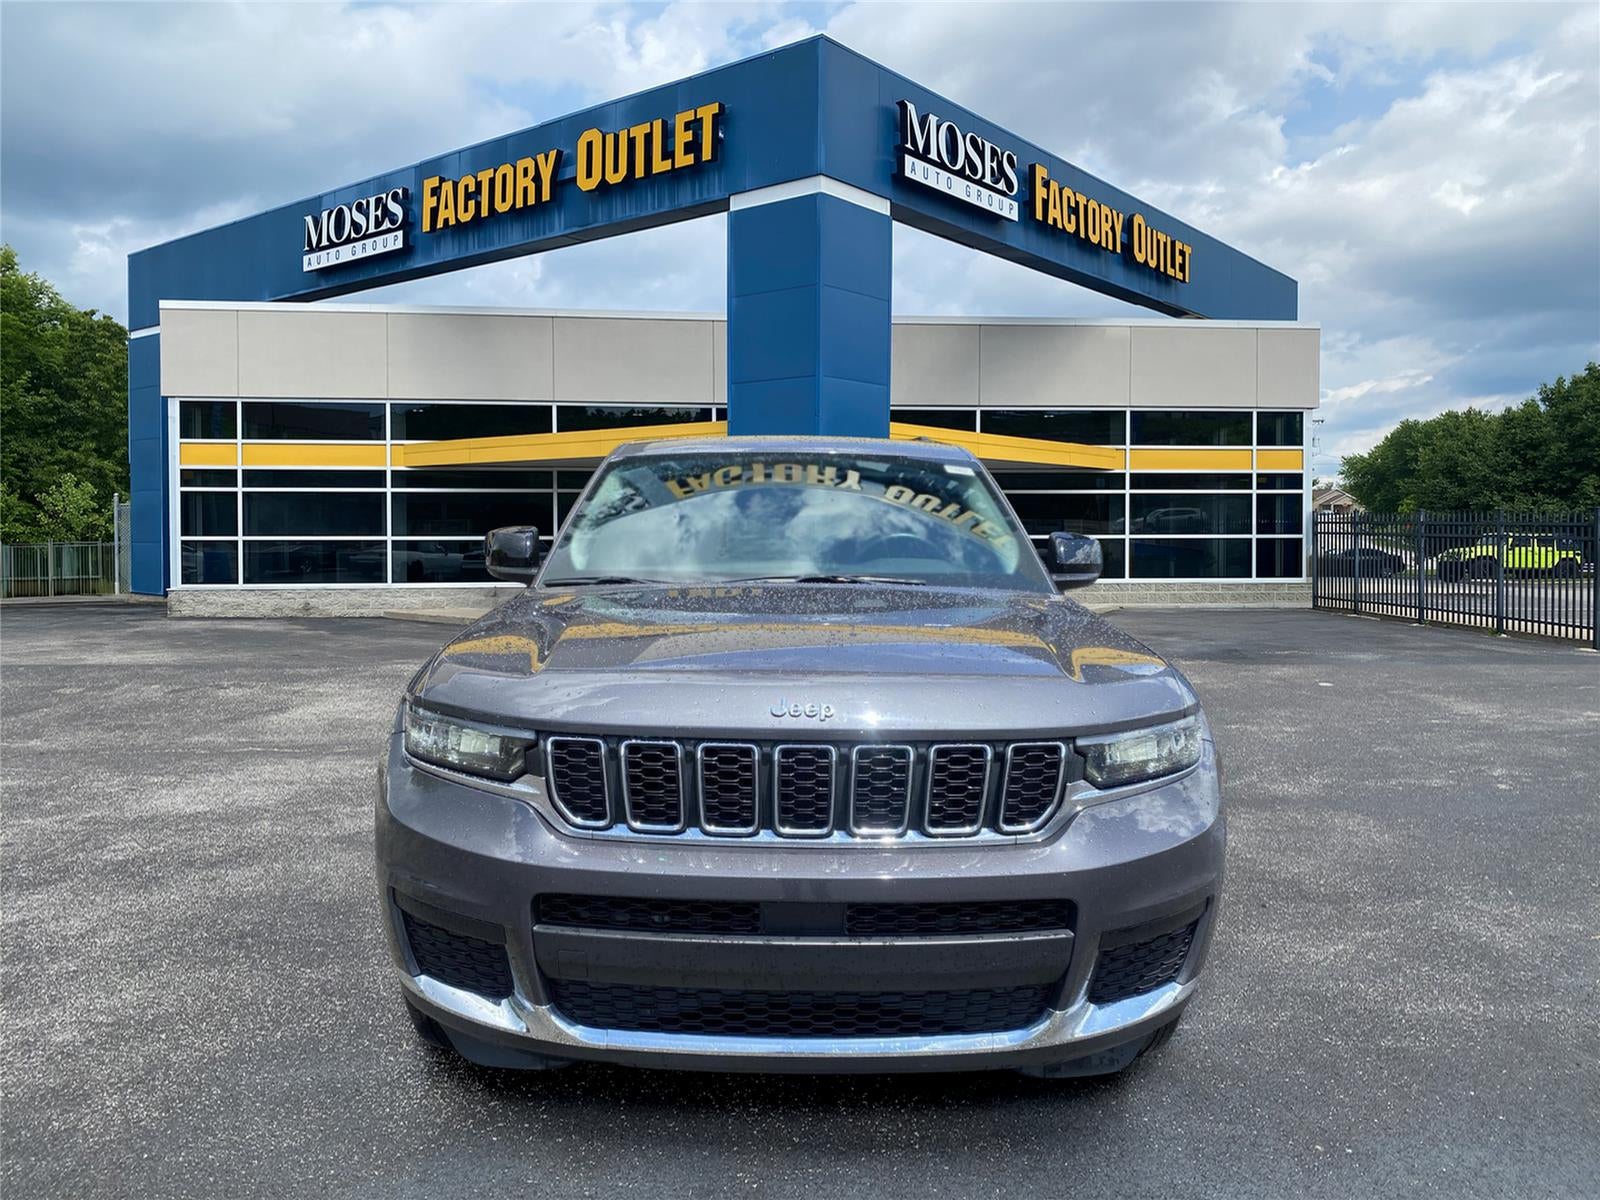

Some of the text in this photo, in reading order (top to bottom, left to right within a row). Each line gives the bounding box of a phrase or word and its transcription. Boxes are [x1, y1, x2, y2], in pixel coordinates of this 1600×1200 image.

[422, 102, 721, 233] FACTORY OUTLET
[904, 100, 1018, 196] MOSES
[303, 187, 404, 251] MOSES
[910, 161, 1014, 215] AUTO GROUP
[307, 234, 399, 268] AUTO GROUP
[1035, 163, 1192, 283] FACTORY OUTLET
[768, 696, 834, 722] Jeep
